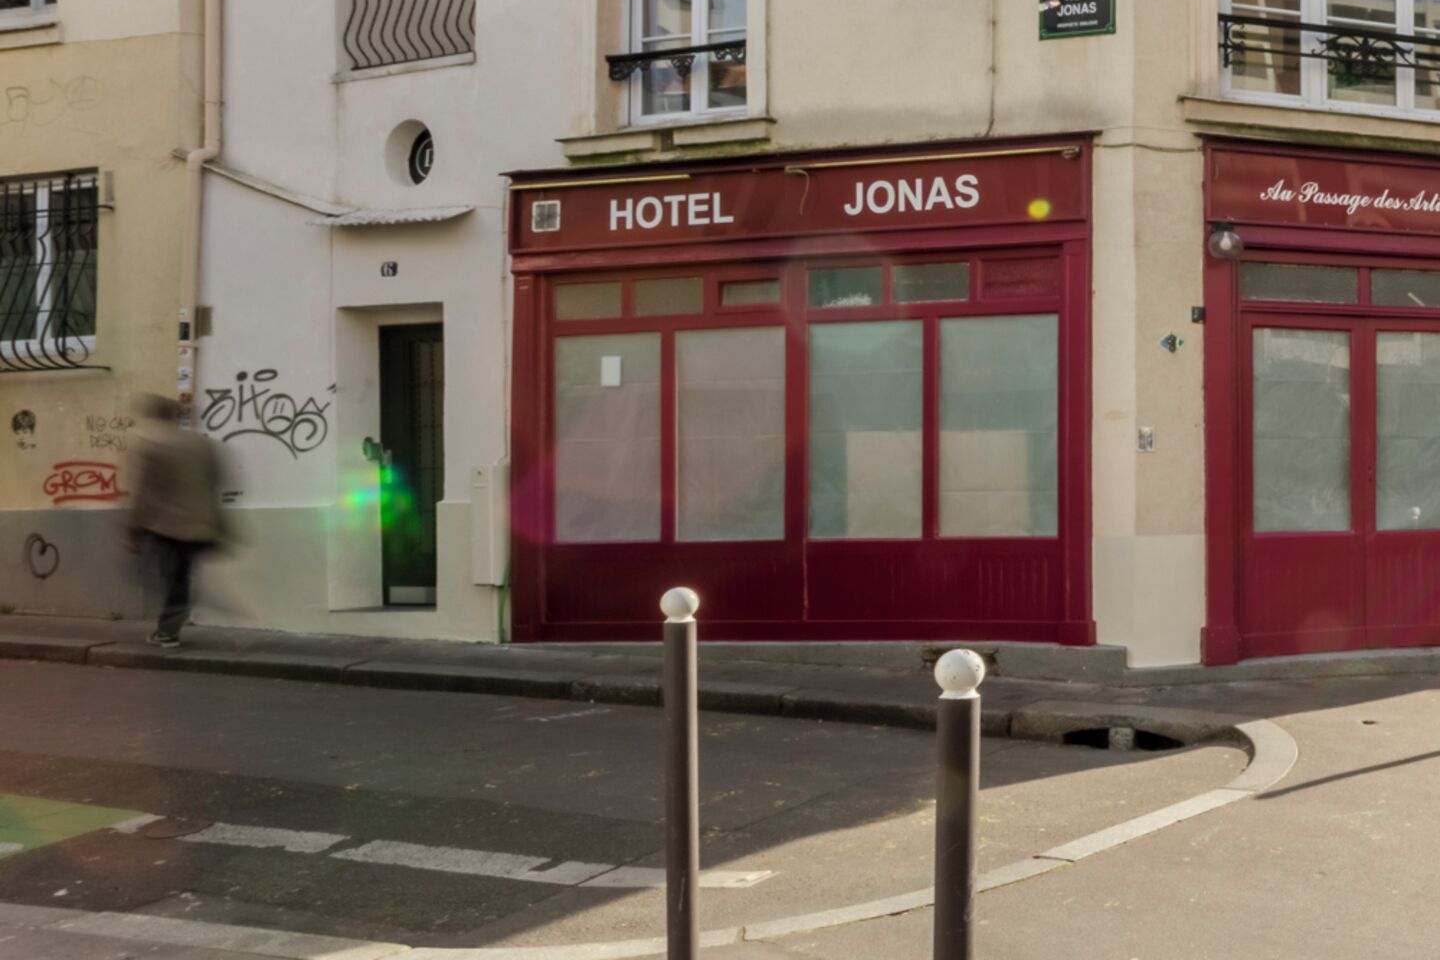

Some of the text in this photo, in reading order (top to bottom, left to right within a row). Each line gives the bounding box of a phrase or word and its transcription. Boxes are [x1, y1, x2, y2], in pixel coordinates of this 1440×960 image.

[1056, 2, 1097, 17] JONAS
[610, 174, 980, 231] HOTEL JONAS
[1260, 179, 1295, 201] Au
[1298, 181, 1372, 215] Passage
[1373, 189, 1402, 210] des
[43, 470, 121, 497] GROM
